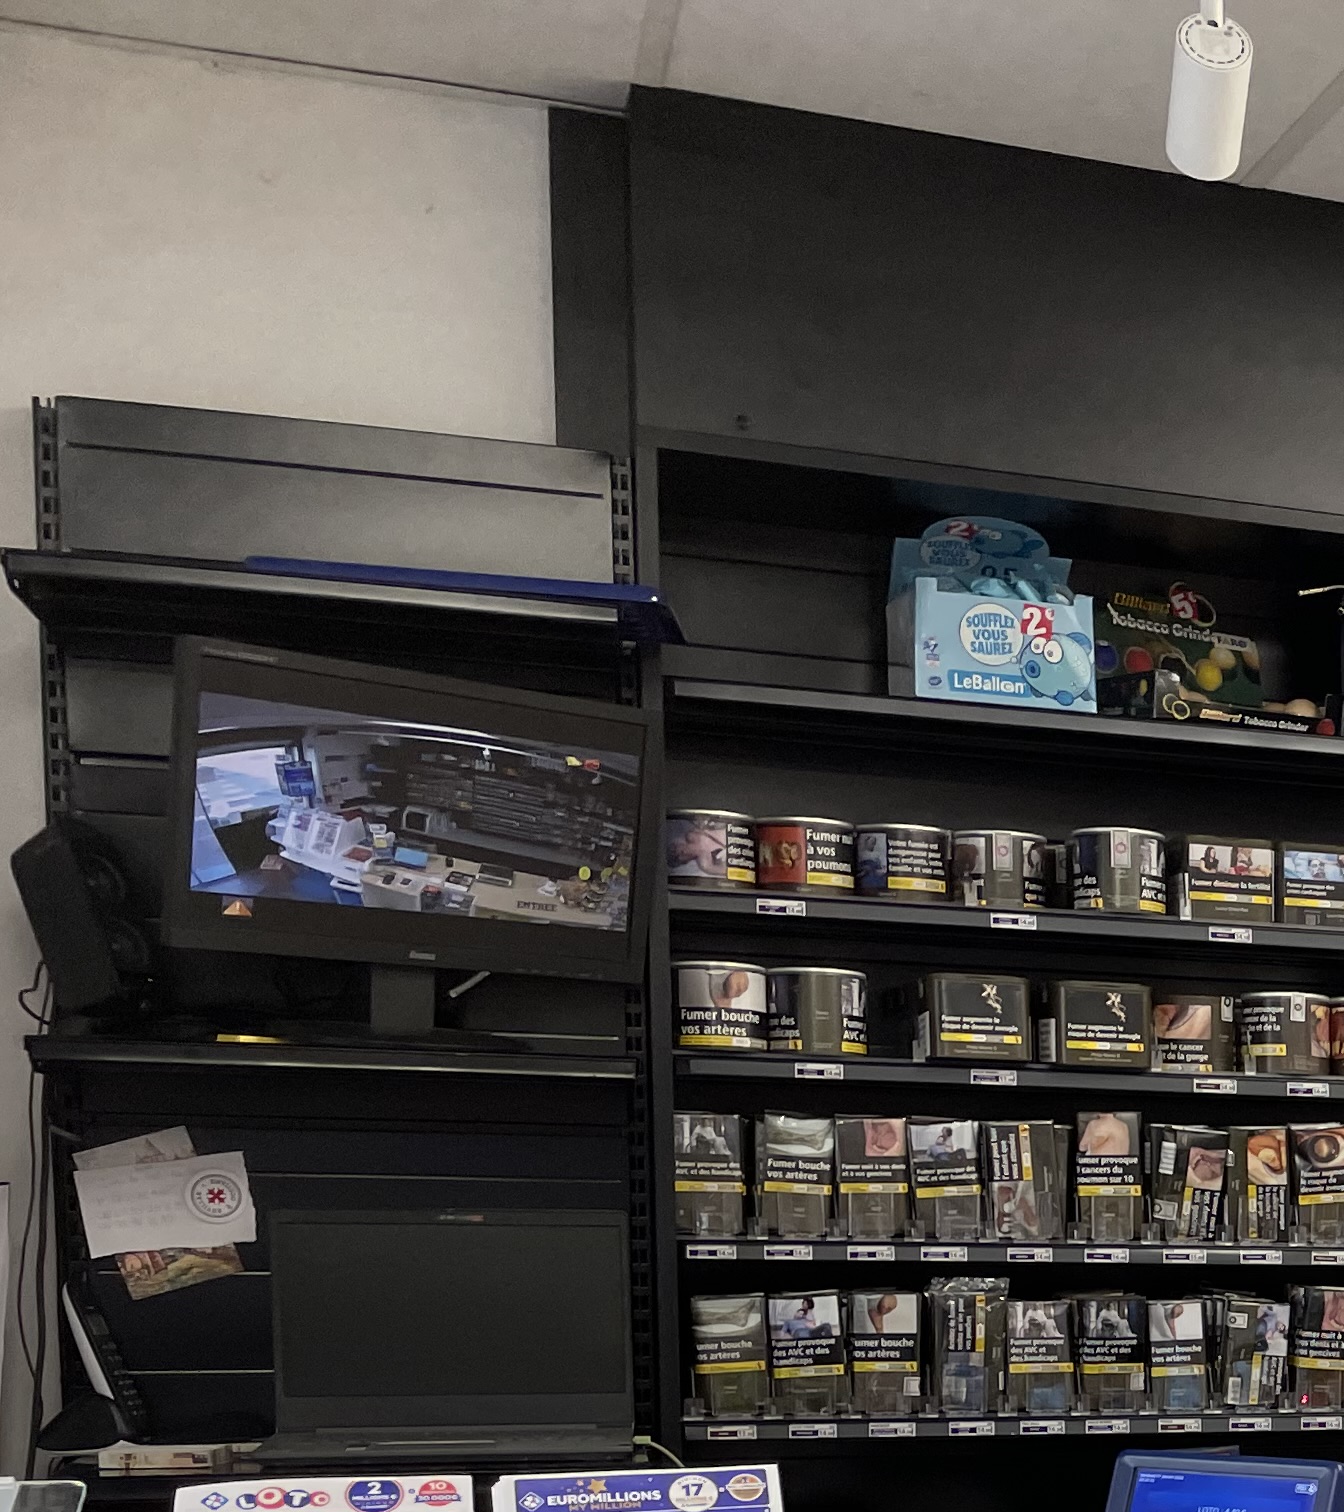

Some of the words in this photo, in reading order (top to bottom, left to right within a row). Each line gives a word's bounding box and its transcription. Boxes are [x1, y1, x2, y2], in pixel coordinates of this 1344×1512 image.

[966, 612, 1016, 629] SOUFFLEZ
[973, 629, 1009, 642] VOUS
[970, 640, 1014, 656] SAUREZ
[954, 673, 1026, 695] LeBallon
[807, 828, 842, 844] Fumer
[807, 844, 814, 857] à
[816, 845, 836, 857] vos
[807, 857, 852, 873] poumons
[681, 1008, 718, 1022] Fumer
[721, 1009, 760, 1024] bouche
[681, 1024, 701, 1035] vos
[703, 1022, 747, 1037] artères
[768, 1157, 794, 1170] Fumer
[796, 1159, 831, 1171] bouche
[767, 1171, 786, 1182] vos
[788, 1170, 818, 1182] artères
[1152, 1345, 1176, 1356] Fumer
[1177, 1345, 1202, 1356] bouche
[1152, 1356, 1164, 1364] vos
[1166, 1353, 1192, 1364] artères
[367, 1481, 382, 1495] 2
[428, 1480, 448, 1491] 10
[681, 1482, 704, 1498] 17
[236, 1486, 330, 1510] LOTO
[547, 1489, 662, 1507] EUROMILLIONS
[568, 1503, 588, 1512] MY
[589, 1500, 642, 1512] MILLION
